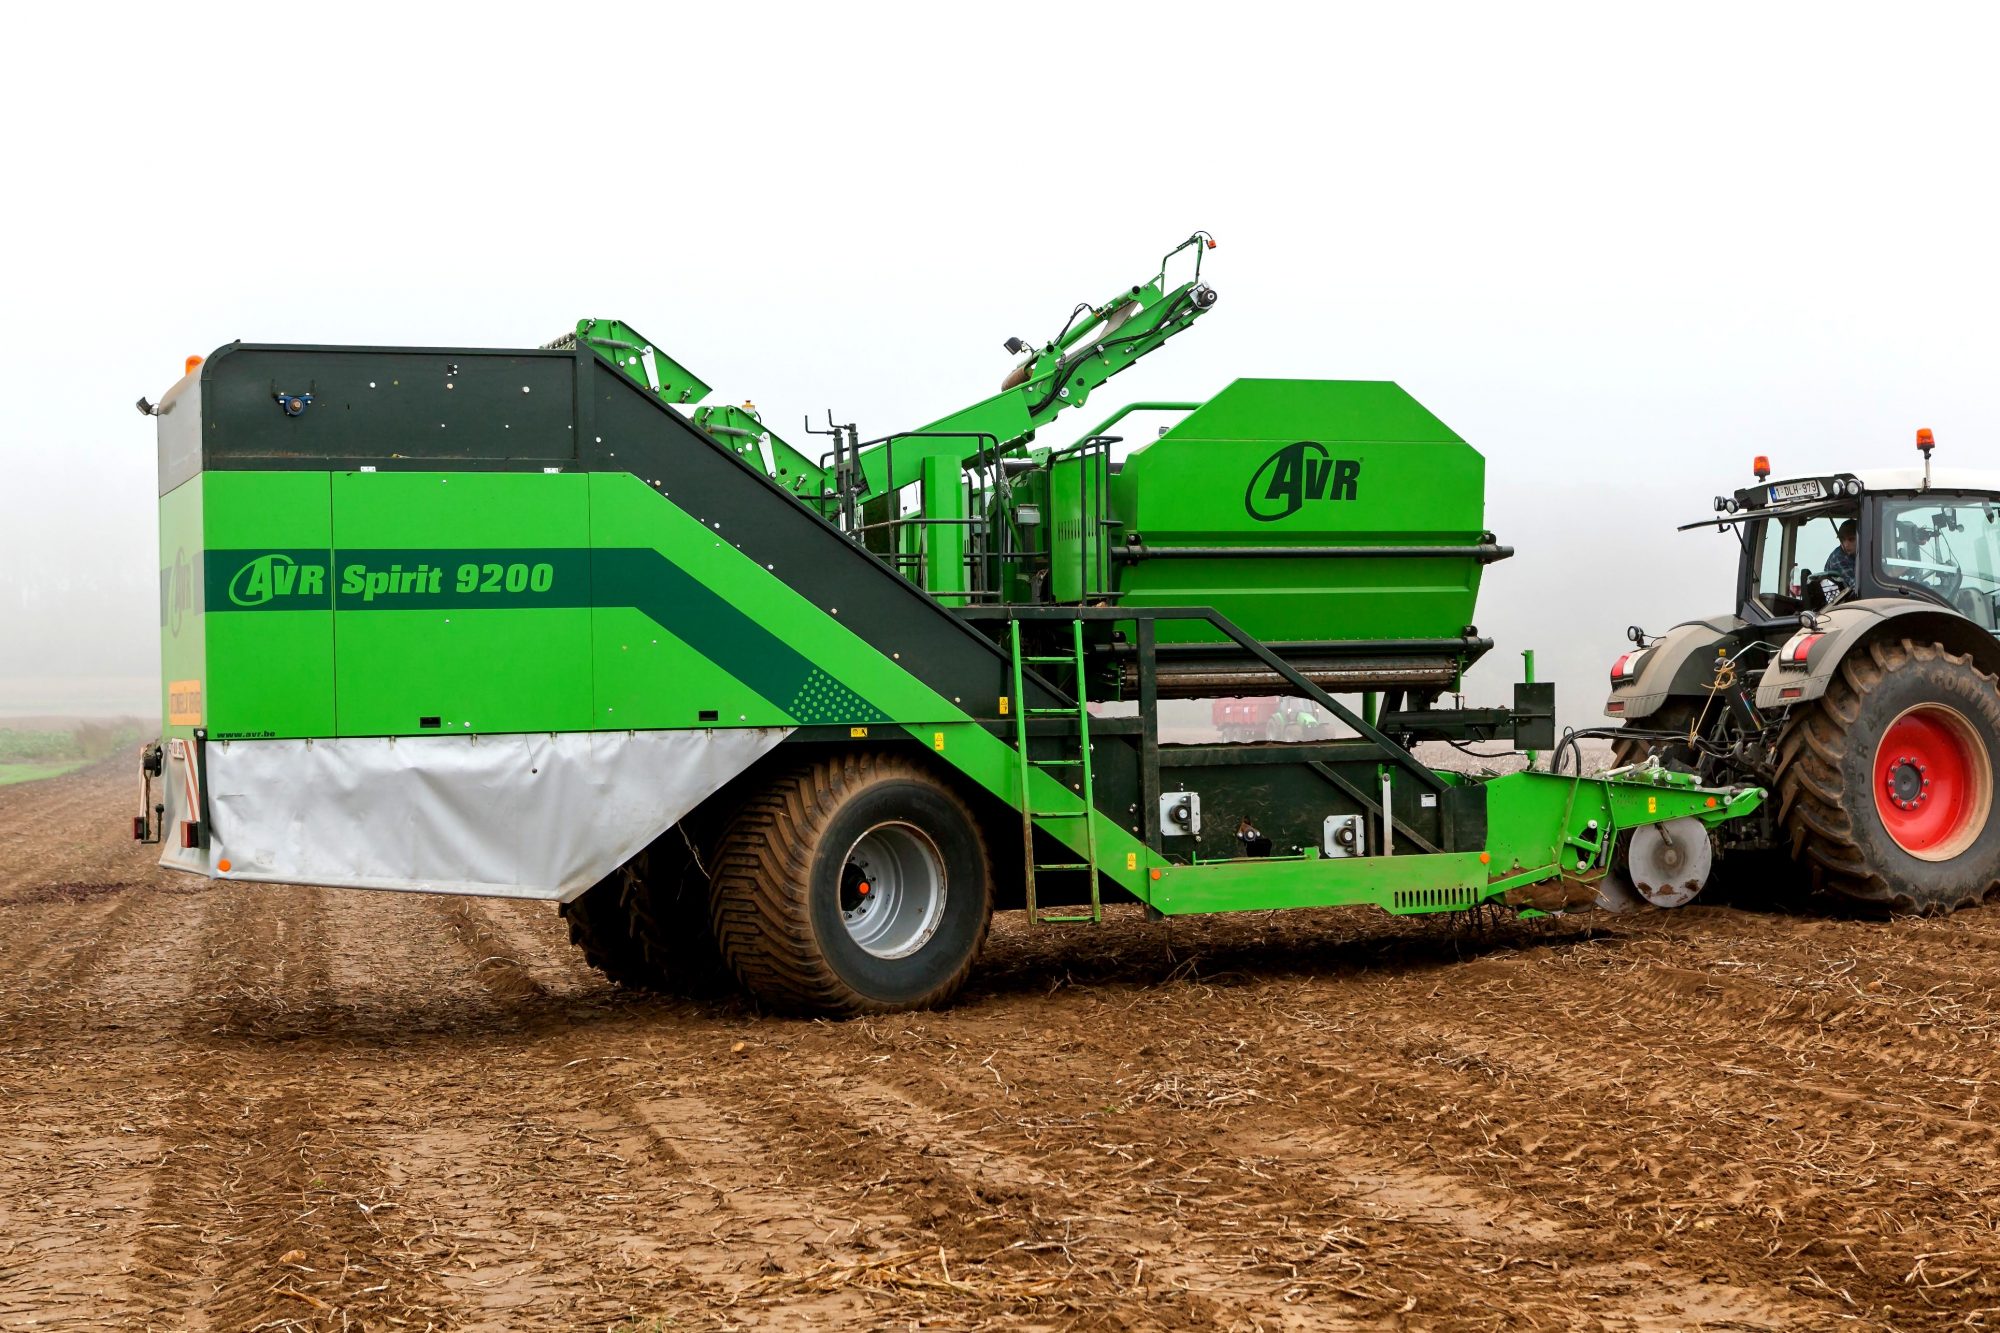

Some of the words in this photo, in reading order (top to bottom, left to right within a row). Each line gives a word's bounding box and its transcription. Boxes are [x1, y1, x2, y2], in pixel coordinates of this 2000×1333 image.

[1245, 441, 1361, 521] AVR
[1776, 482, 1817, 497] 1-DLH-979
[229, 554, 325, 606] AVR
[341, 564, 443, 601] Spirit
[456, 563, 554, 593] 9200
